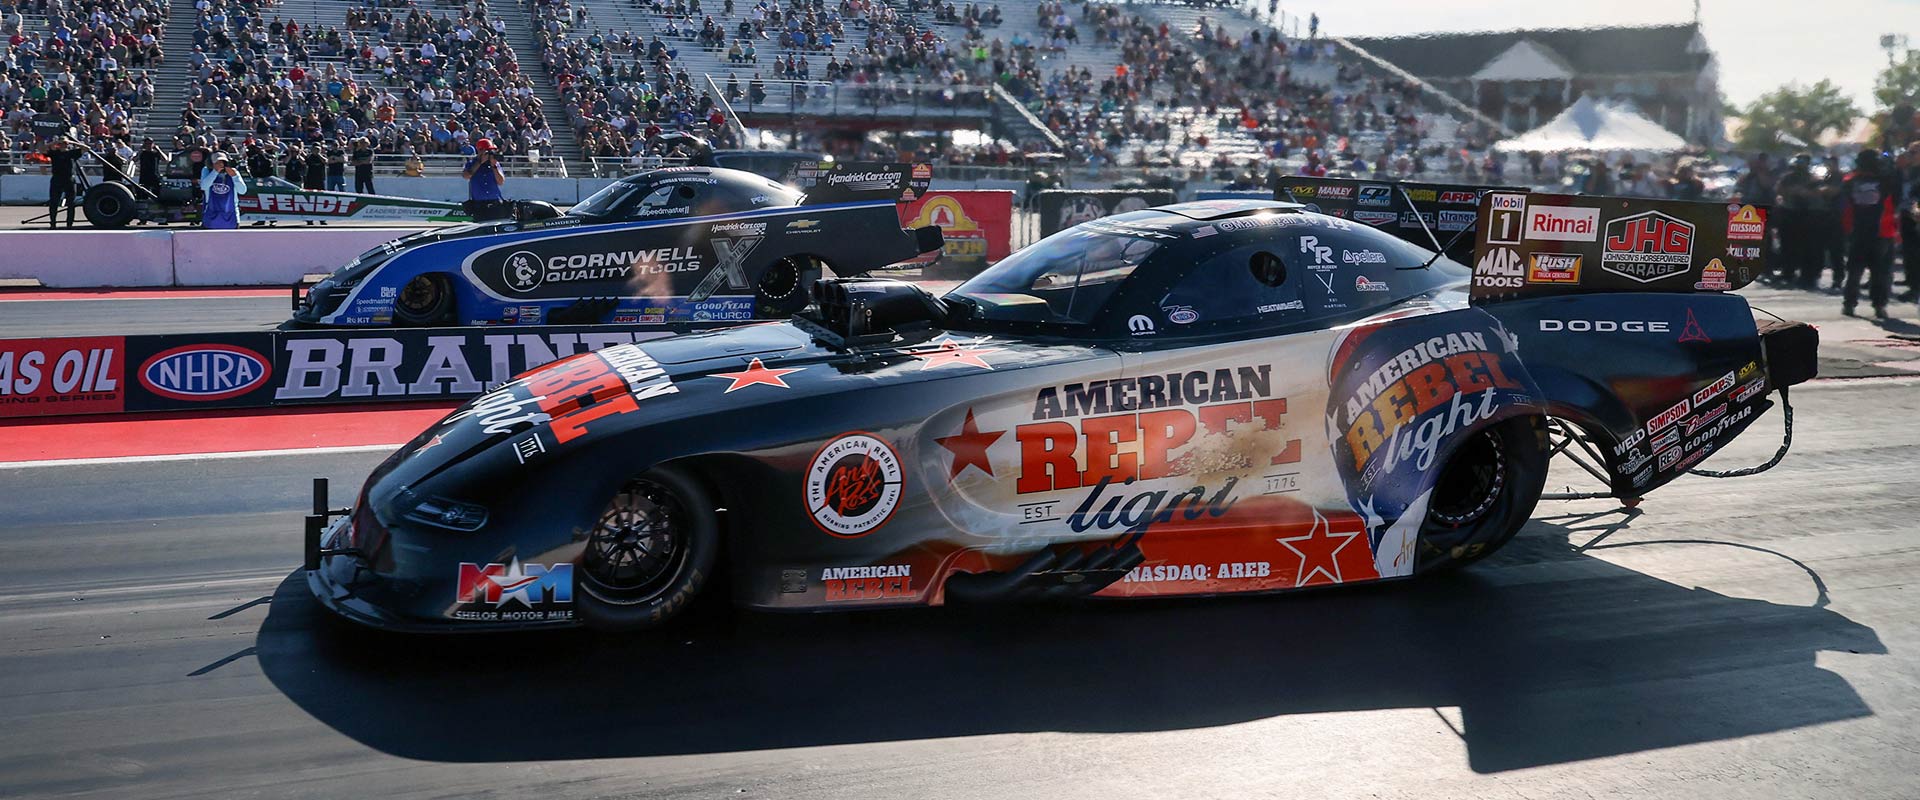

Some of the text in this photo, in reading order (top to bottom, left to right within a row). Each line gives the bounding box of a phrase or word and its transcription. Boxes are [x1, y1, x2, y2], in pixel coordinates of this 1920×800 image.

[1317, 187, 1352, 196] MANLEY
[1440, 191, 1476, 202] ARP
[257, 193, 357, 213] FENDT
[1493, 197, 1523, 208] Mobil
[1400, 212, 1434, 223] JEEL
[1500, 212, 1511, 239] 1
[1533, 213, 1592, 234] Rinnai
[1607, 217, 1691, 254] JHG
[547, 246, 698, 270] CORNWELL
[1475, 247, 1525, 276] MAC
[1639, 255, 1690, 263] HORSEPOWERED
[1733, 247, 1760, 257] ALL STAR
[546, 261, 701, 282] QUALITY TOOLS
[1535, 255, 1577, 272] RUSH
[1616, 263, 1676, 277] GARAGE
[1474, 276, 1524, 287] TOOLS
[695, 300, 752, 311] GOODYEAR
[712, 311, 752, 320] HURCO
[1539, 319, 1670, 333] DODGE
[53, 348, 117, 394] OIL
[159, 353, 254, 391] NHRA
[597, 343, 680, 401] ERICAN
[1346, 331, 1489, 422] AMERICAN
[45, 393, 116, 403] SERIES
[1032, 364, 1272, 420] AMERICAN
[1695, 378, 1726, 404] COMP
[1345, 351, 1528, 473] REBEL
[1649, 401, 1687, 433] SIMPSON
[1382, 386, 1500, 474] light
[1684, 405, 1752, 452] GOODYEAR
[518, 437, 540, 458] 1776
[1613, 428, 1646, 457] WELD
[1653, 431, 1679, 450] CHAMPION
[812, 440, 897, 503] THE AMERICAN REBEL
[1266, 477, 1297, 491] 1776
[823, 489, 897, 530] BURNING PATRIOTIC FUEL
[1024, 505, 1053, 519] EST
[820, 564, 911, 580] AMERICAN
[1123, 561, 1271, 583] NASDAQ: AREB
[824, 576, 917, 602] REBEL
[456, 610, 574, 620] SHELOR MOTOR MILE
